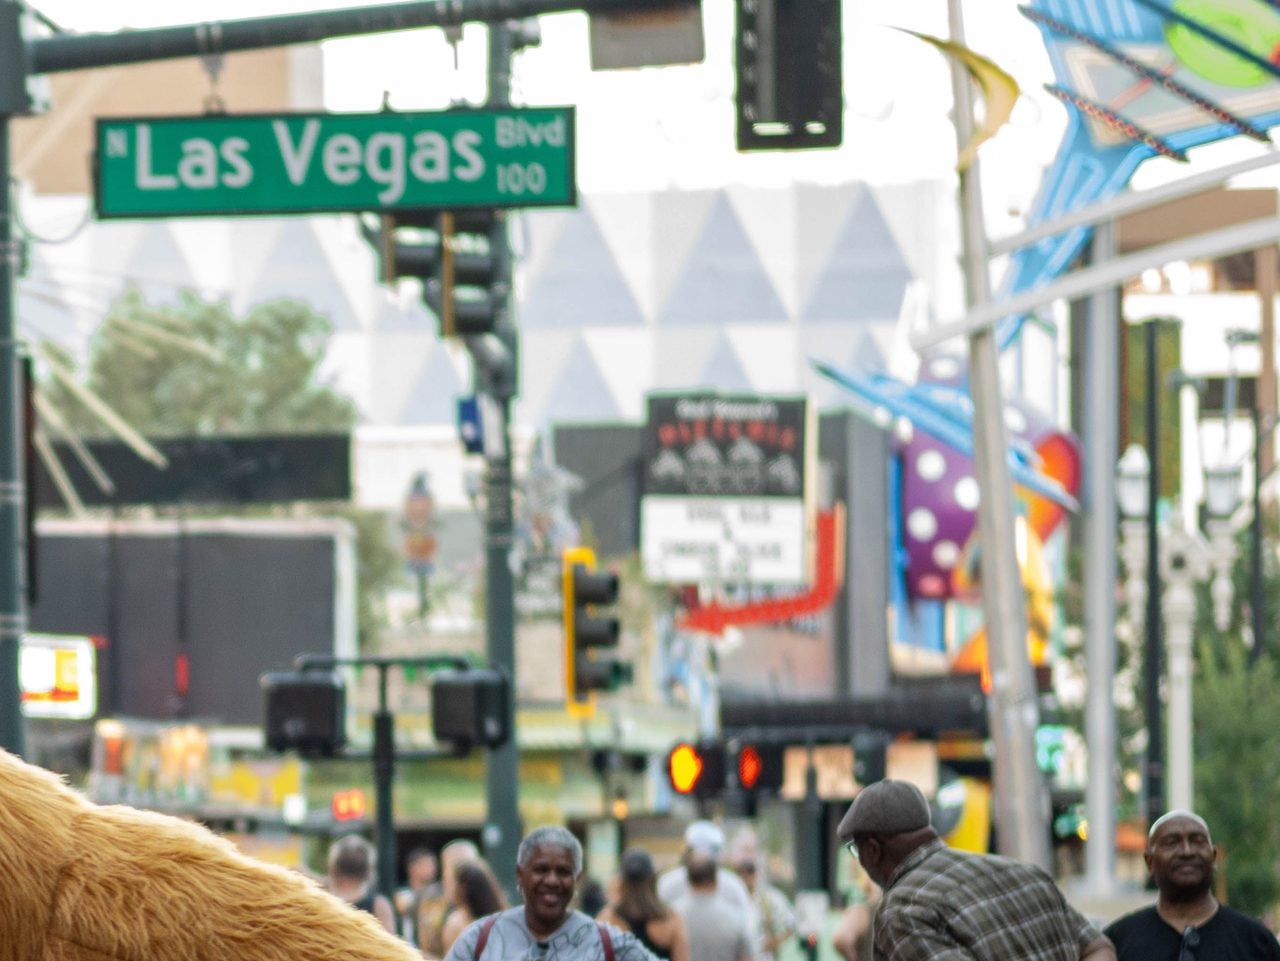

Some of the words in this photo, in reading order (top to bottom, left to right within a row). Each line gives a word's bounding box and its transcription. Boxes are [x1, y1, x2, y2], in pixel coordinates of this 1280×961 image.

[105, 128, 128, 159] N
[135, 122, 254, 190] Las
[271, 117, 486, 204] Vegas
[494, 114, 567, 148] Blvd
[496, 162, 547, 195] 100
